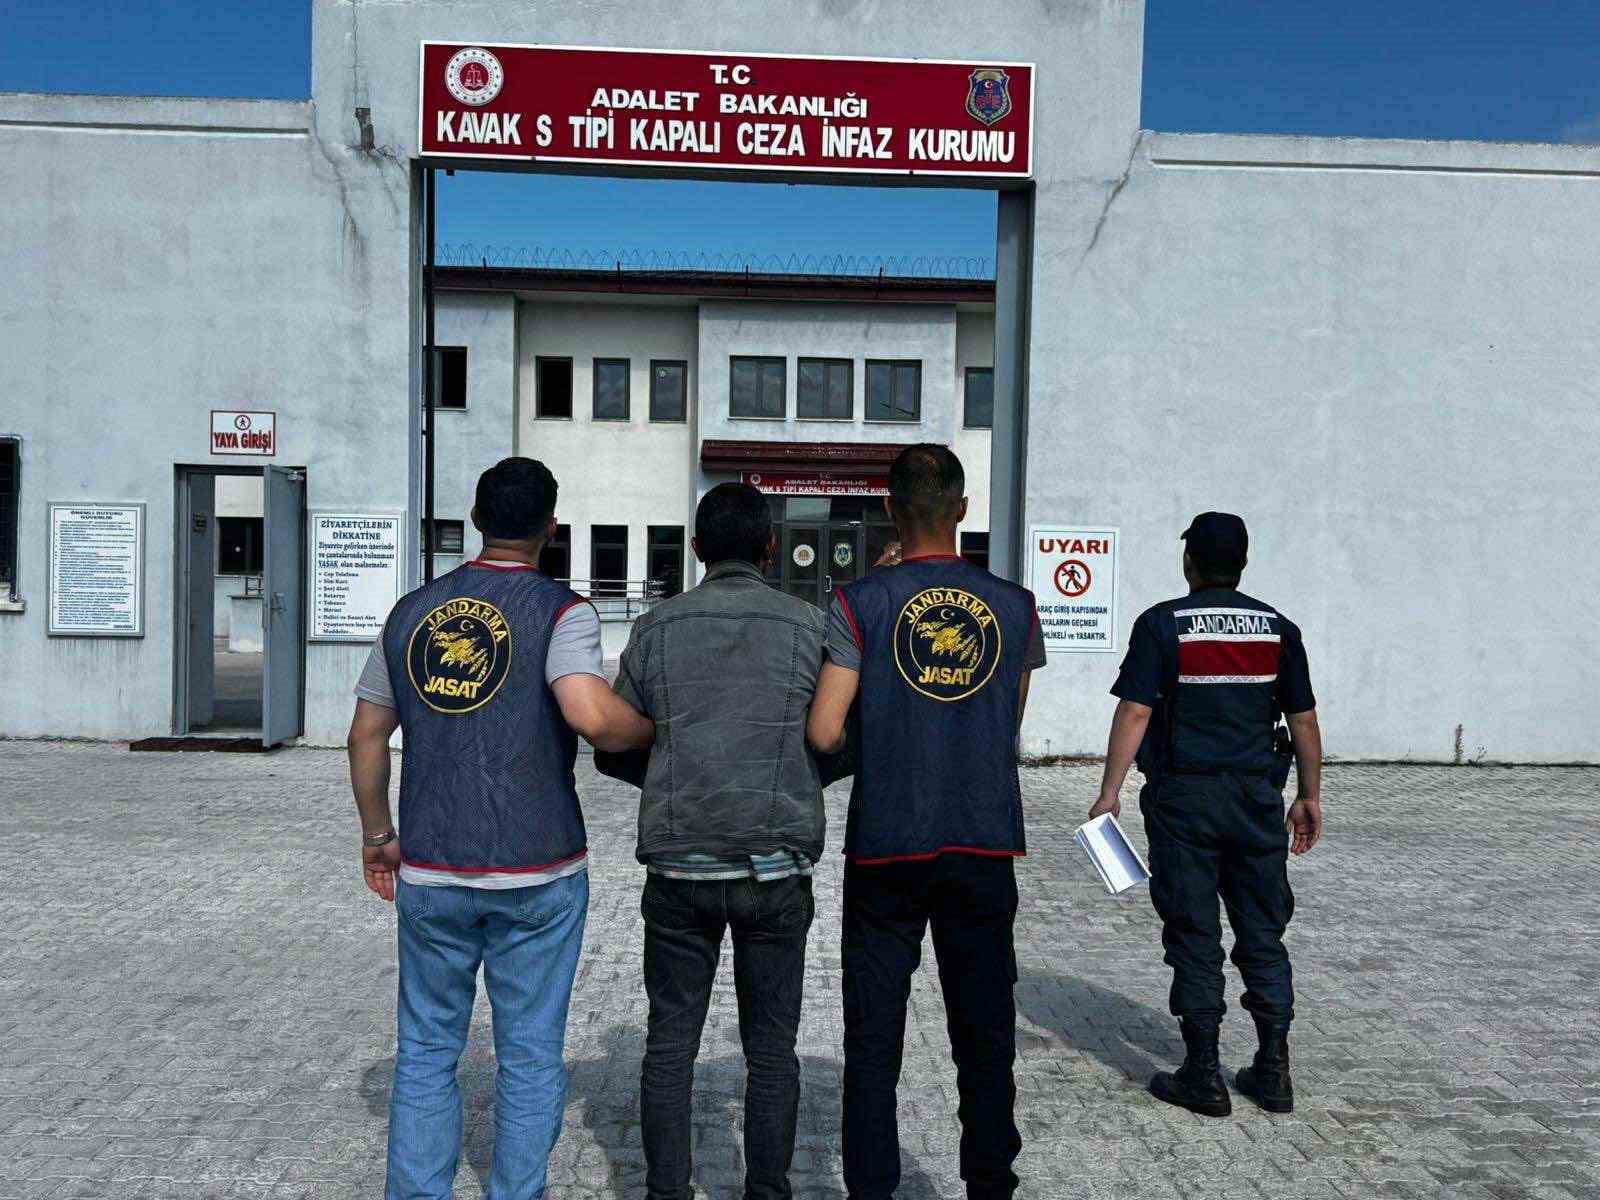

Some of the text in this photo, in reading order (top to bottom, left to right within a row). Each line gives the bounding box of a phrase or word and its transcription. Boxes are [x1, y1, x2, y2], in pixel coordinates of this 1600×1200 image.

[590, 87, 868, 121] ADALET BAKANLIĞI
[437, 108, 1015, 164] KAVAK S TİPİ KAPALI CEZA İNFAZ KURUMU
[214, 429, 272, 453] YAYA GİRİŞİ
[320, 519, 393, 530] ZİYARETÇİLERİN
[332, 531, 382, 541] DİKKATİNE
[1039, 538, 1109, 554] UYARI
[340, 560, 353, 568] olan
[904, 591, 993, 630] JANDARMA
[1054, 604, 1071, 615] GİRİŞ
[1071, 606, 1108, 614] KAPISINDAN
[1071, 618, 1098, 628] GEÇMESİ
[1187, 615, 1272, 634] JANDARMA
[918, 666, 975, 685] JASAT
[423, 675, 482, 699] JASAT
